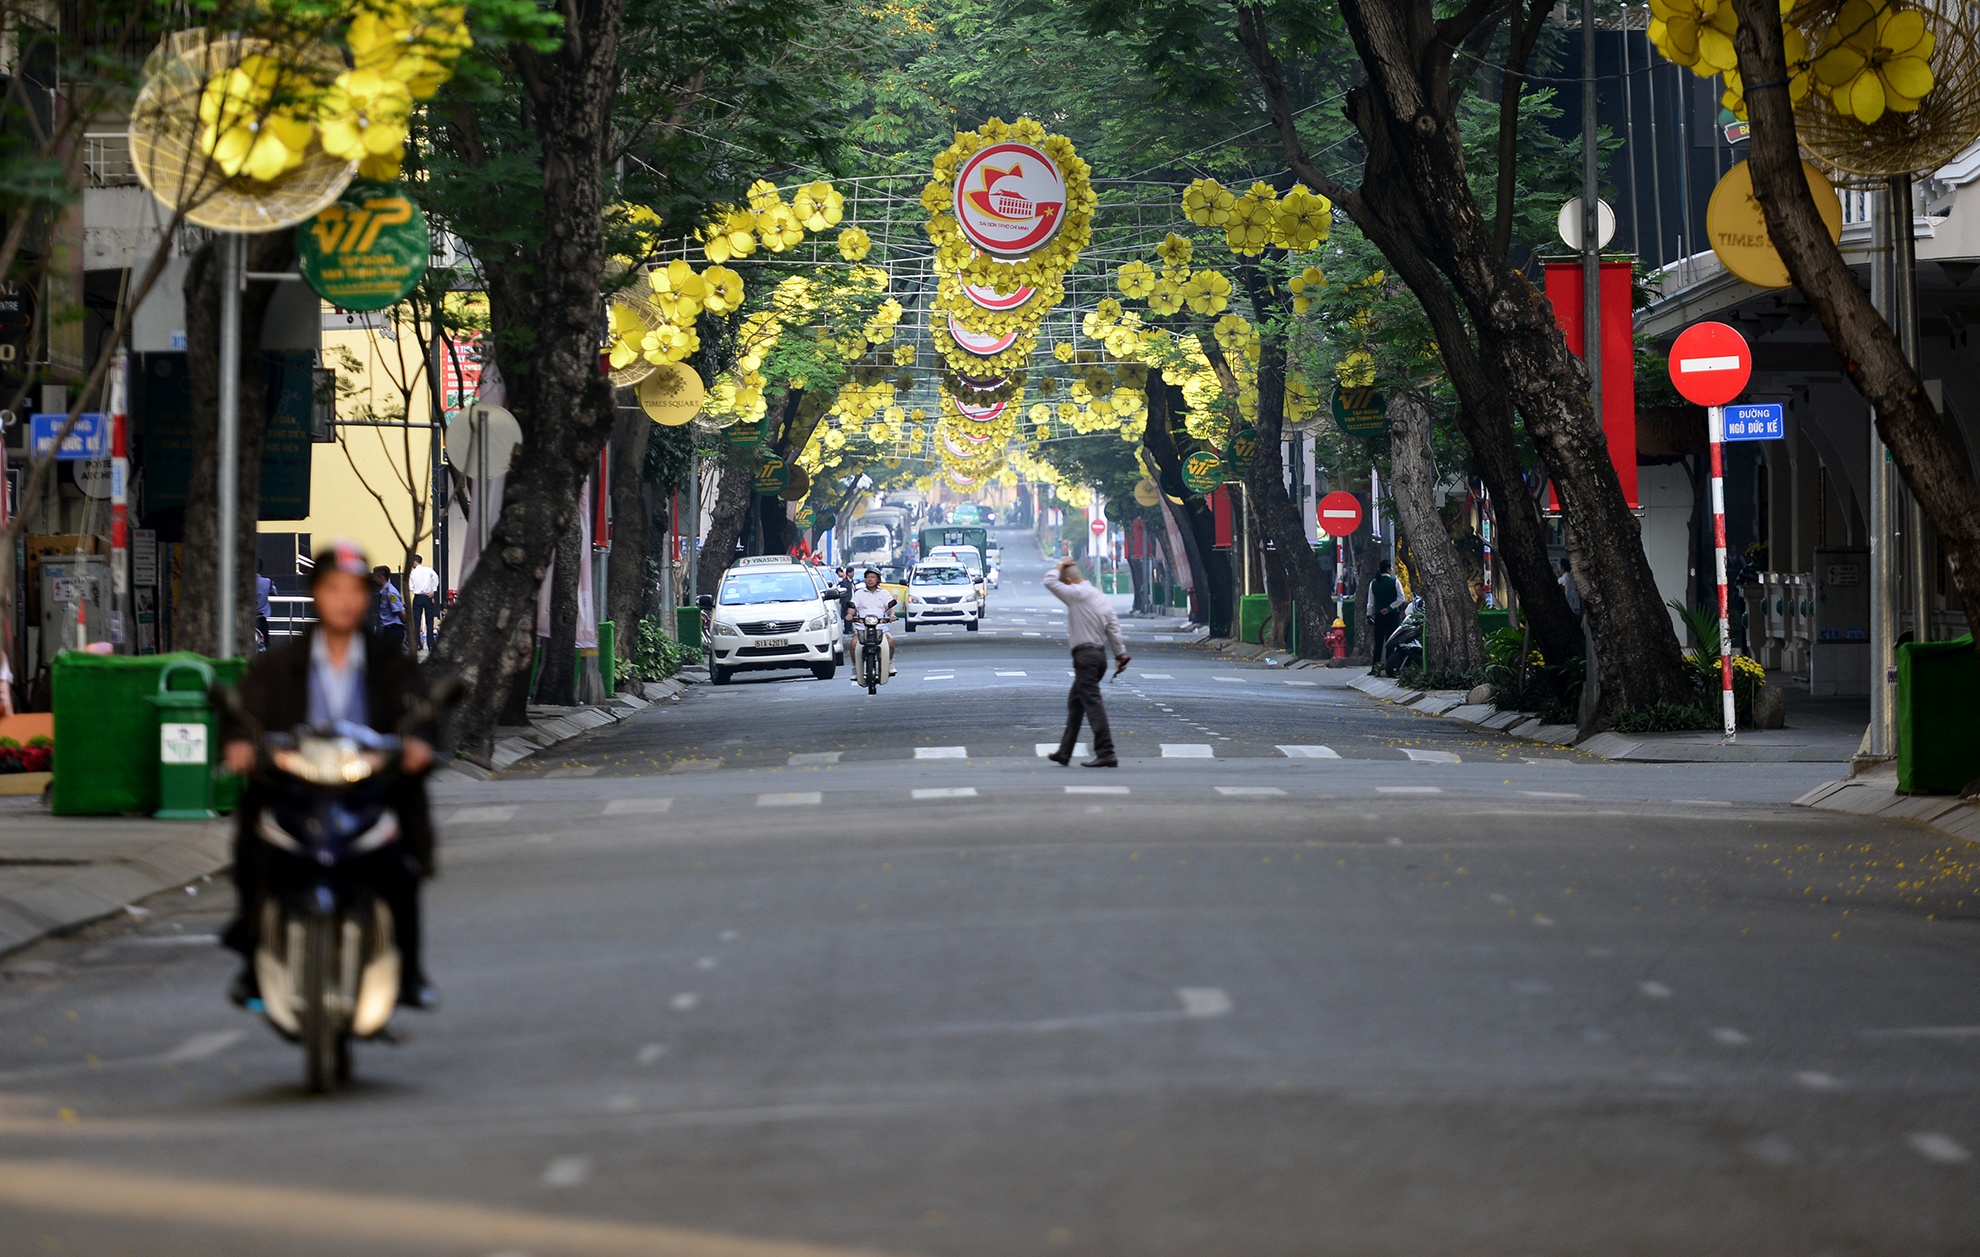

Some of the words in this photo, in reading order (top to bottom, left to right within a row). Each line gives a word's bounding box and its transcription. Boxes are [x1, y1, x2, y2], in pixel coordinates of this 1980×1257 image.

[1718, 233, 1764, 247] TIMES
[1739, 408, 1770, 419] ĐƯỜNG
[1729, 421, 1745, 435] NGÔ
[1748, 419, 1764, 434] ĐỨC
[1767, 418, 1778, 433] KẾ
[85, 460, 112, 469] POSTE
